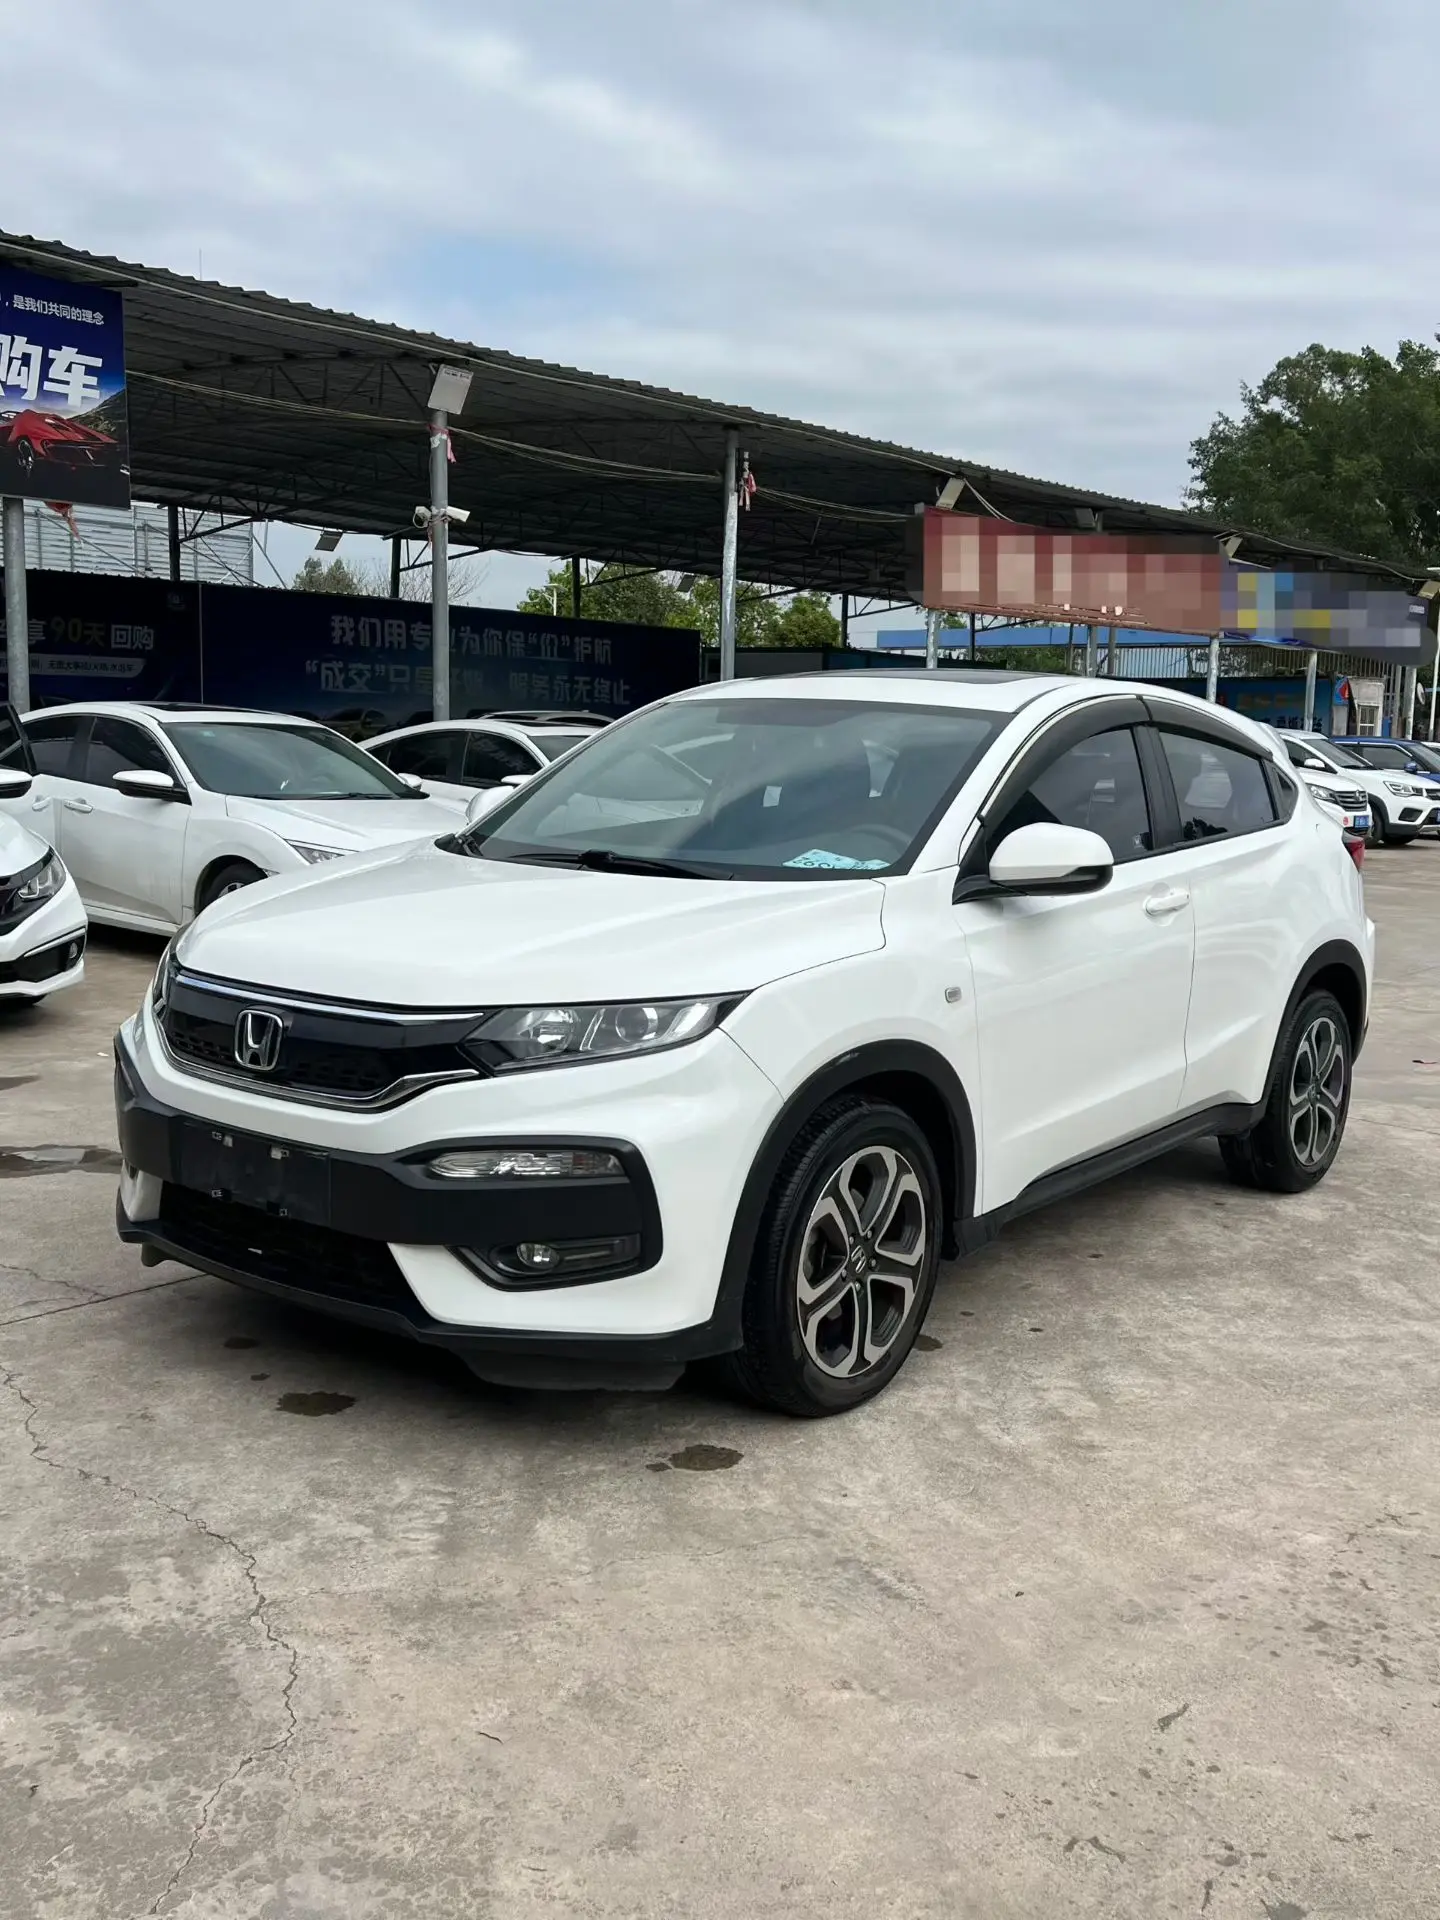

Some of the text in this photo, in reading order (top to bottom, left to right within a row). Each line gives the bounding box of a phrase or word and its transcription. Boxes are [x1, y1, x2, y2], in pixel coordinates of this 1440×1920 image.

[0, 293, 105, 326] ，是我们共同的理念
[0, 333, 103, 408] 购车
